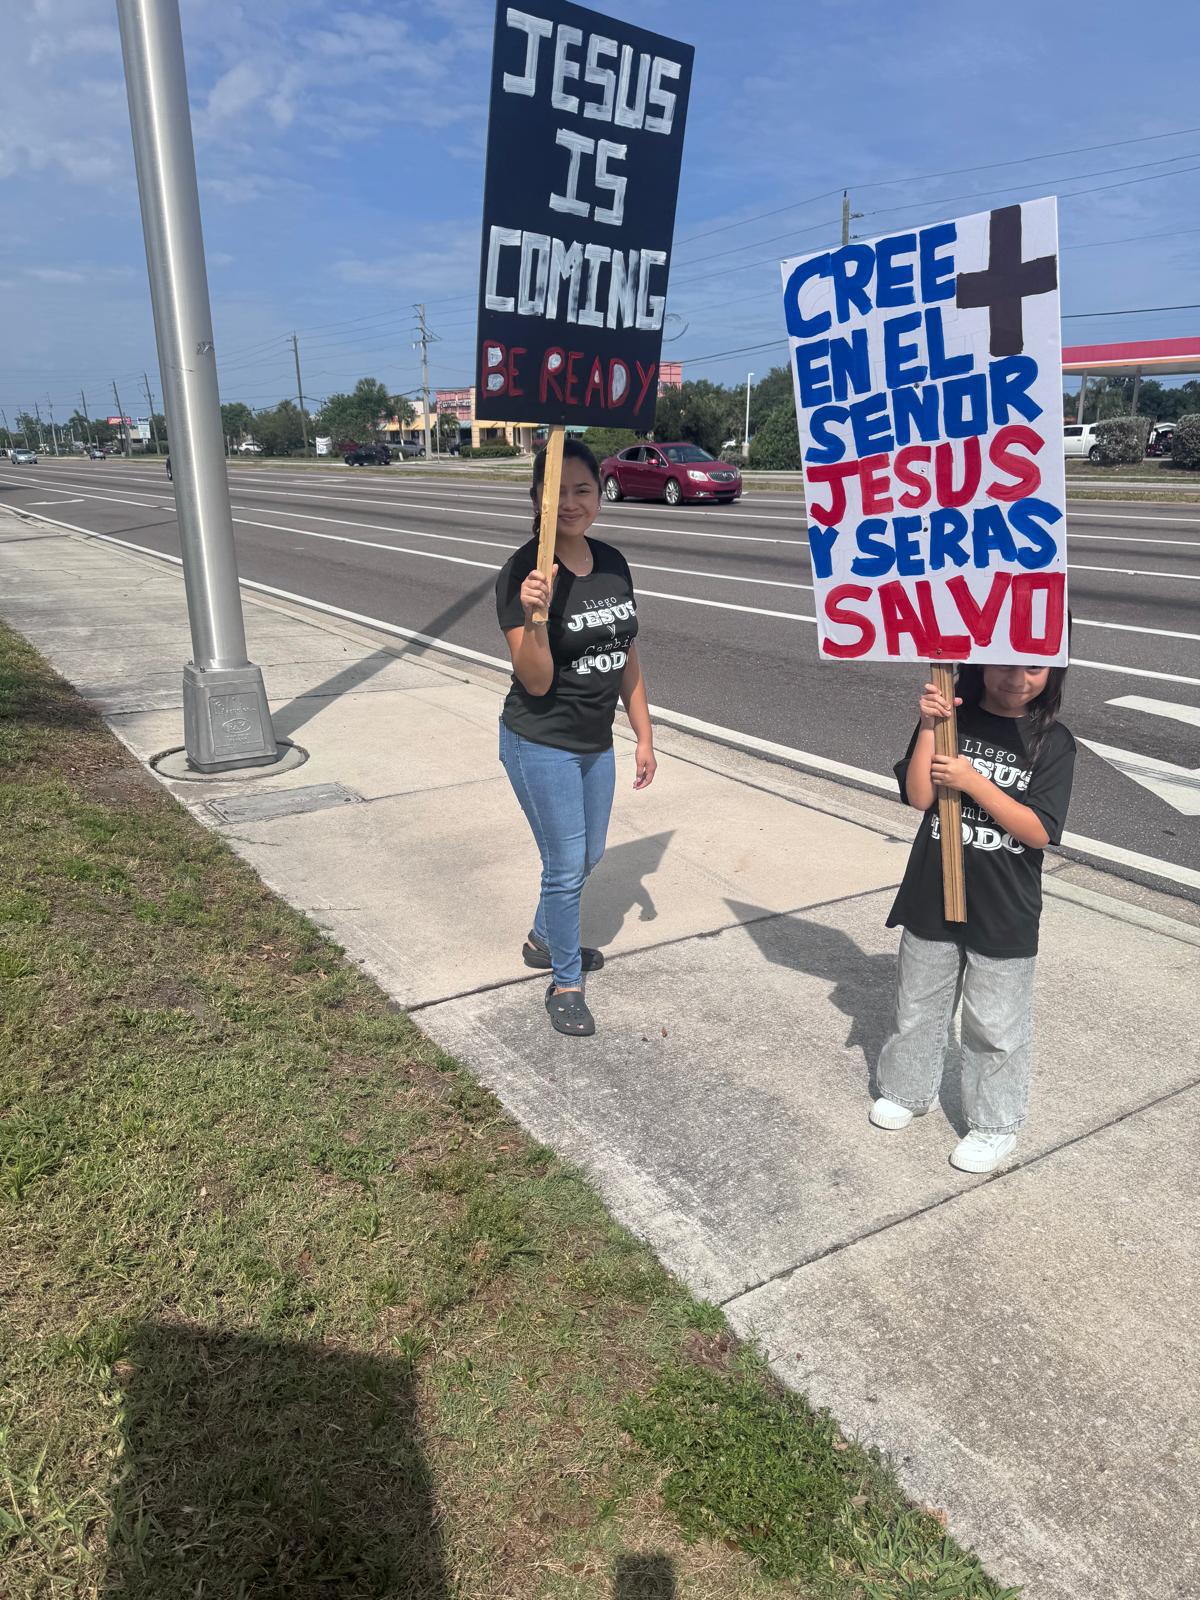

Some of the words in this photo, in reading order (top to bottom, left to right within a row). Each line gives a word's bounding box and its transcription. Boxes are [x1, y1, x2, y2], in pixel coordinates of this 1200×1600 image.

[503, 7, 681, 135] JESUS
[549, 128, 627, 226] IS
[485, 225, 666, 331] COMING
[783, 223, 957, 338] CREE
[481, 340, 527, 399] BE
[539, 347, 656, 416] READY
[796, 329, 871, 408] EN
[884, 307, 974, 389] EL
[805, 355, 1043, 463] SENOR
[806, 424, 1046, 527] JESUS
[808, 525, 839, 579] Y
[851, 497, 1063, 577] SERAS
[582, 596, 617, 610] Llego
[822, 571, 1066, 660] SALVO
[571, 651, 629, 674] TOD
[961, 754, 1033, 792] SUS
[962, 739, 1017, 763] Llego
